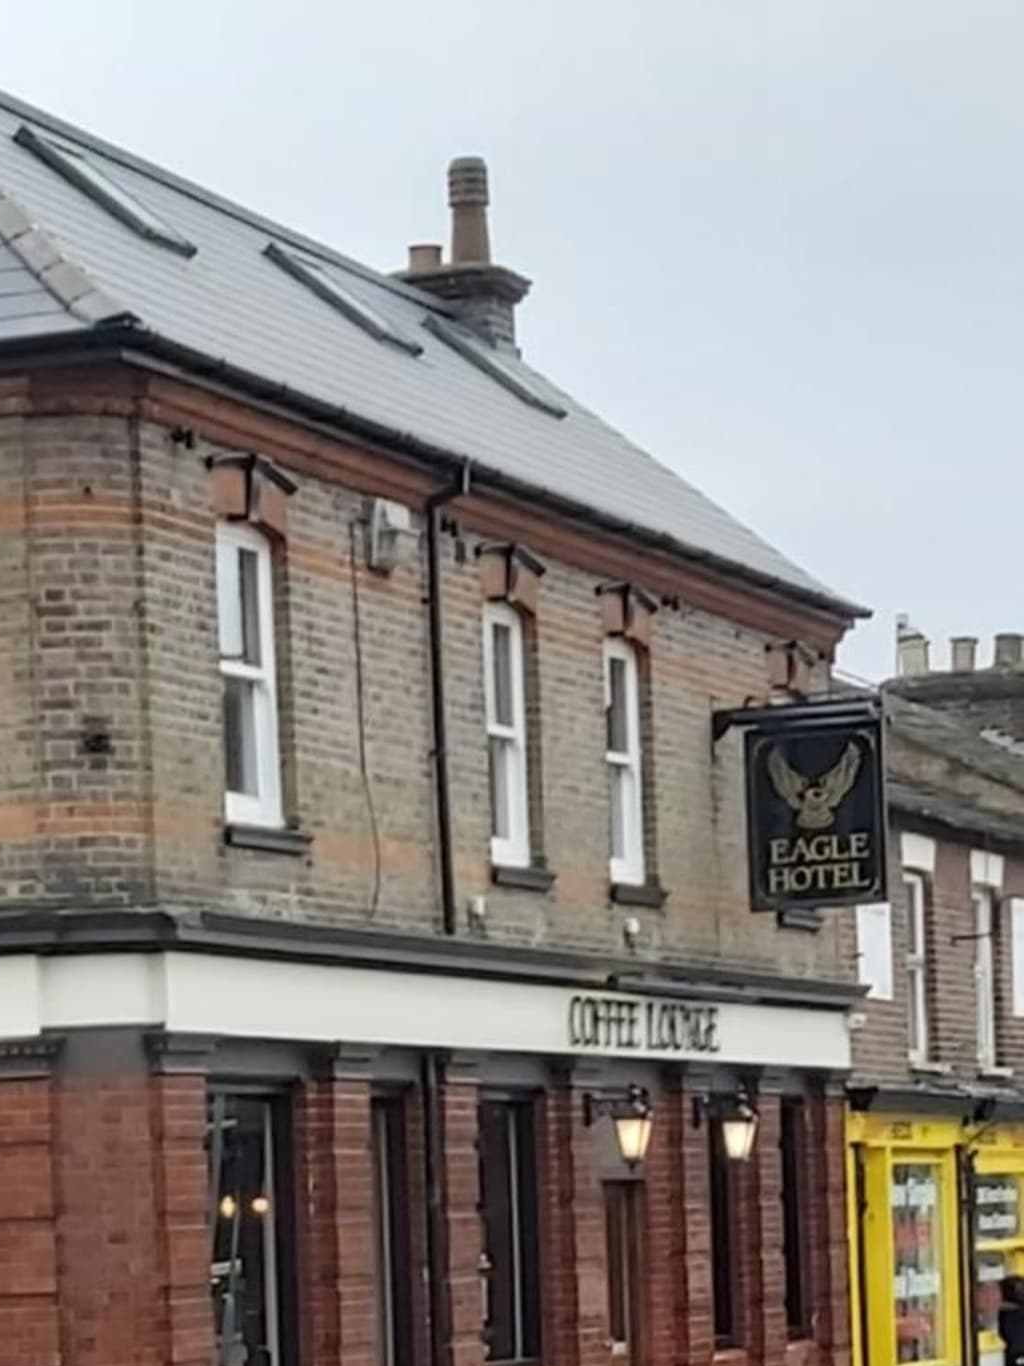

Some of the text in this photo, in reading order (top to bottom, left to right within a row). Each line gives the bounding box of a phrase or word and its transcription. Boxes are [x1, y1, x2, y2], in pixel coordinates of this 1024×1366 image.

[769, 832, 870, 864] EAGLE
[768, 862, 871, 893] HOTEL
[568, 995, 641, 1048] COFFEE
